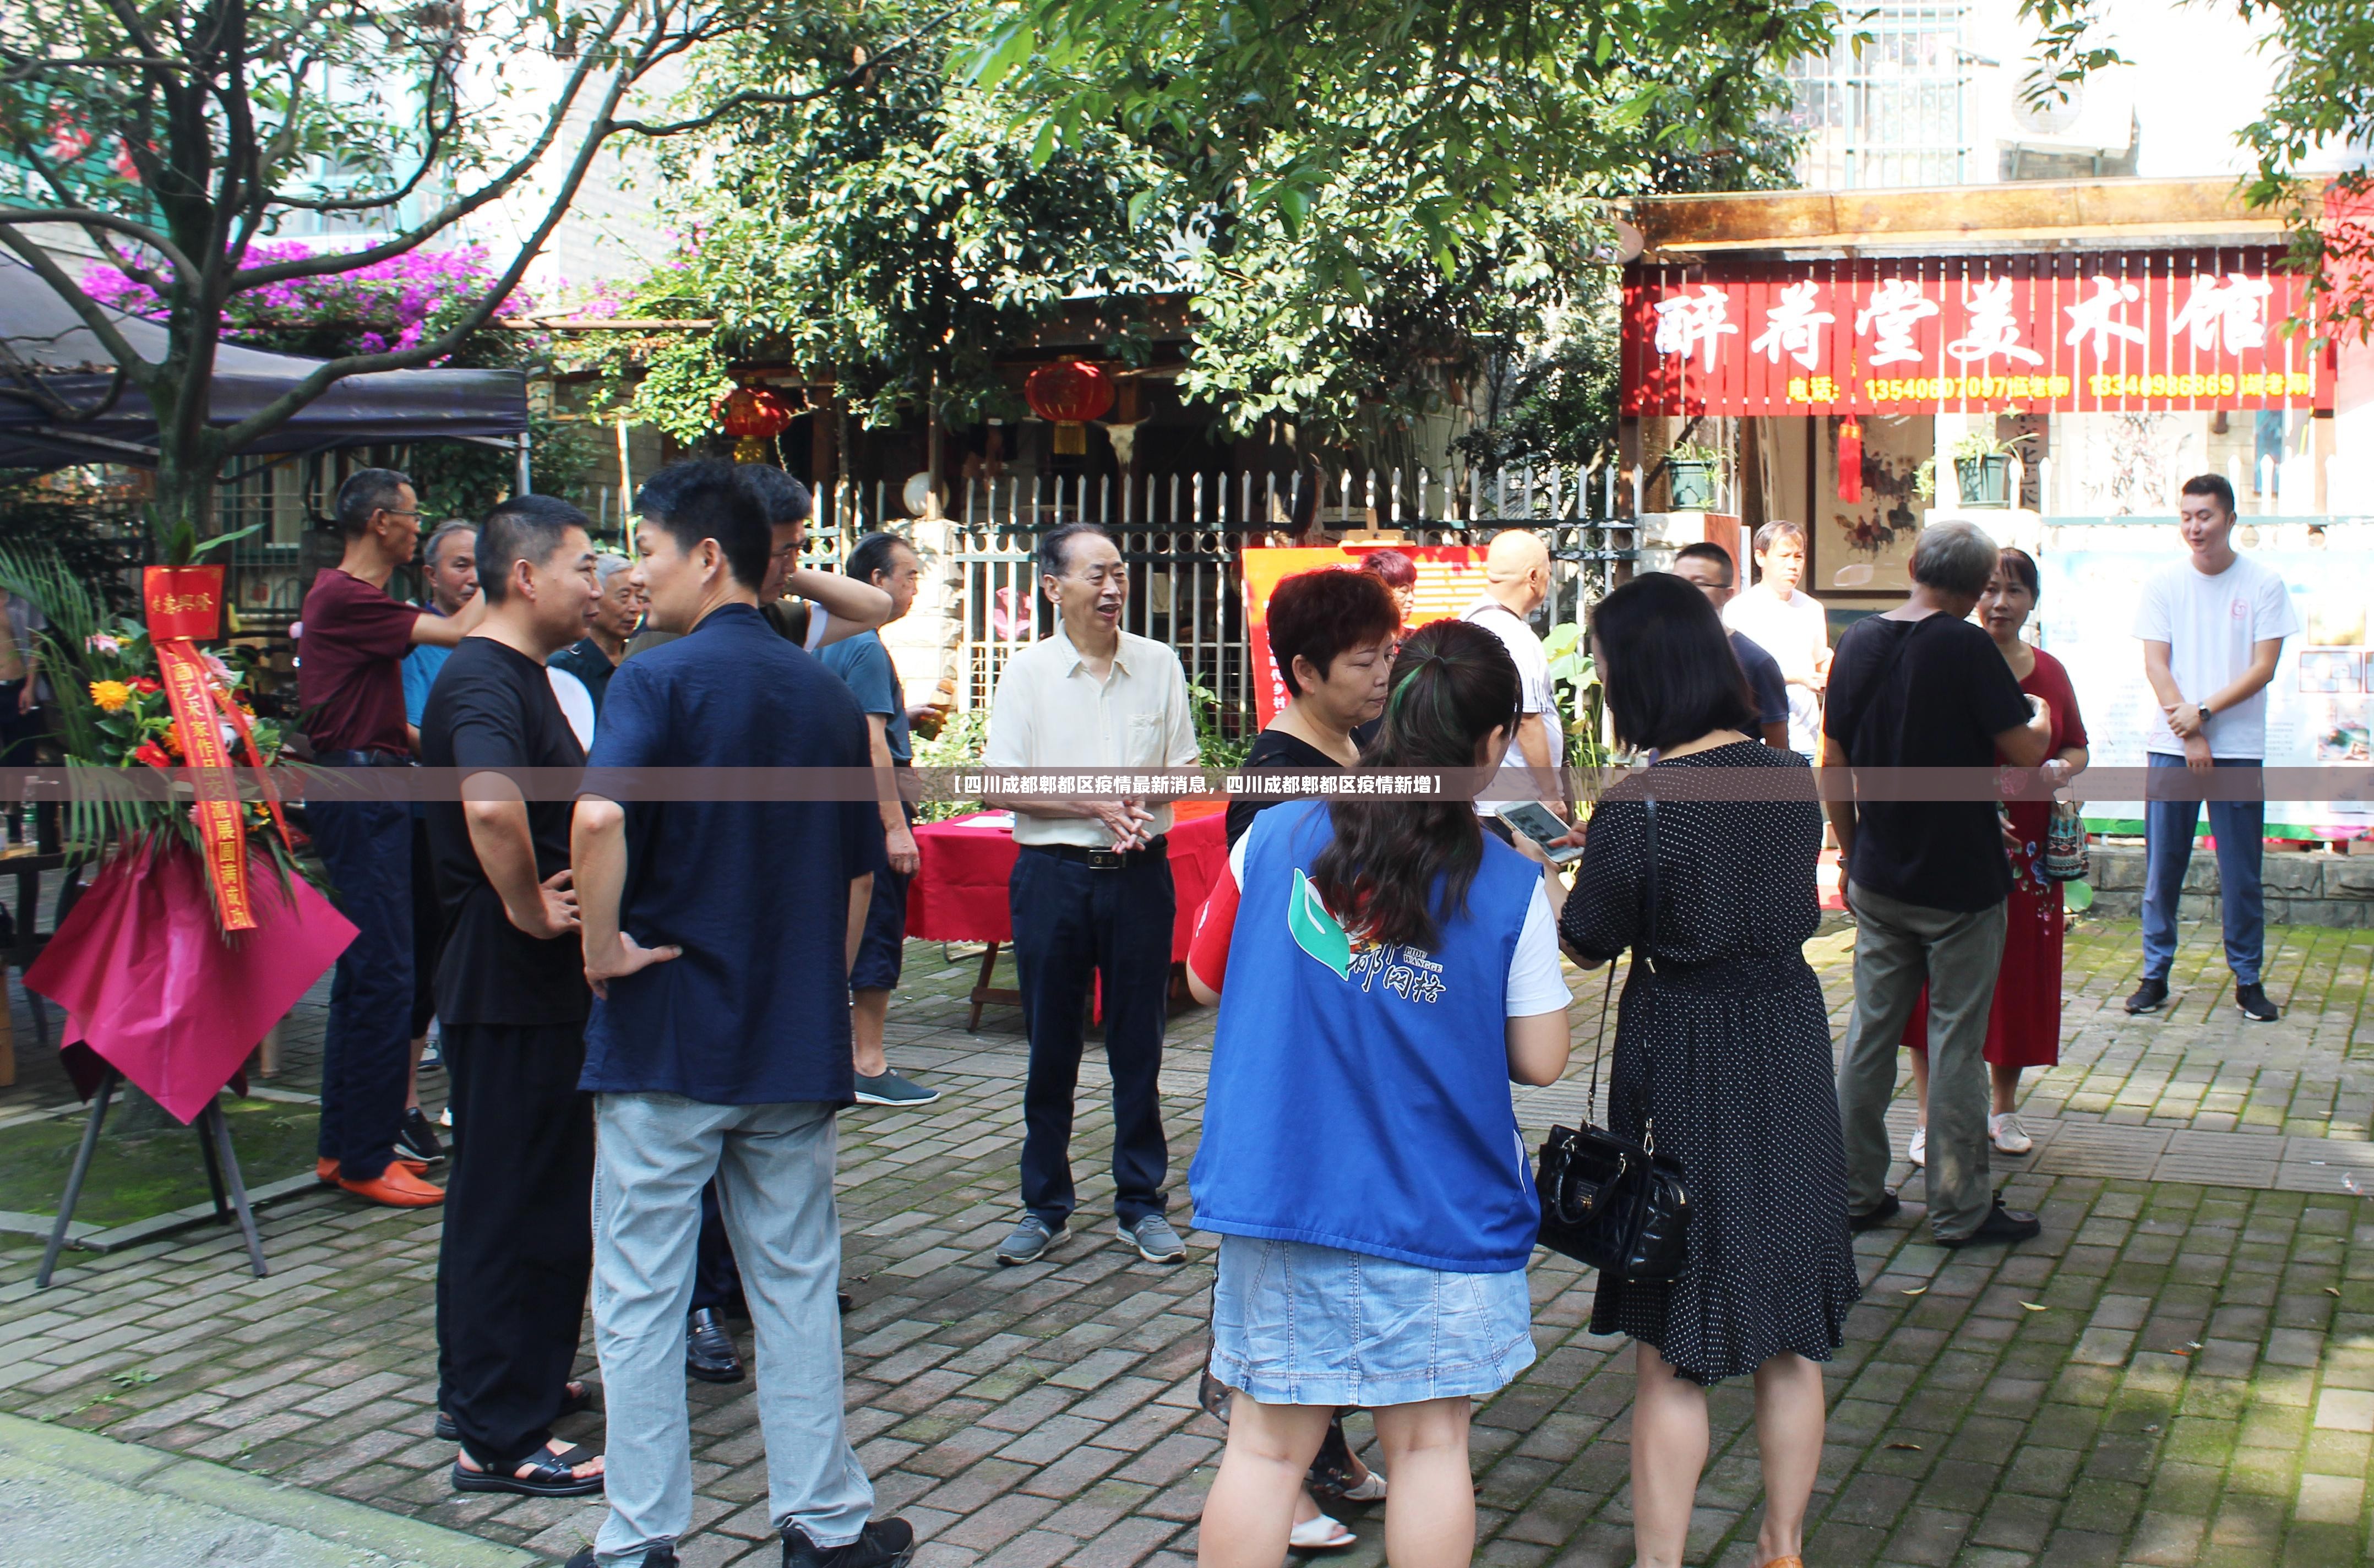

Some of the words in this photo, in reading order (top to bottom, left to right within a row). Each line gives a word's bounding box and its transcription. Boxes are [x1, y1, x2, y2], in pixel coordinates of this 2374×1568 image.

[1653, 273, 2273, 374] 醉荷堂美术馆
[1404, 946, 1427, 959] PIDU
[1403, 954, 1443, 973] WANGGE
